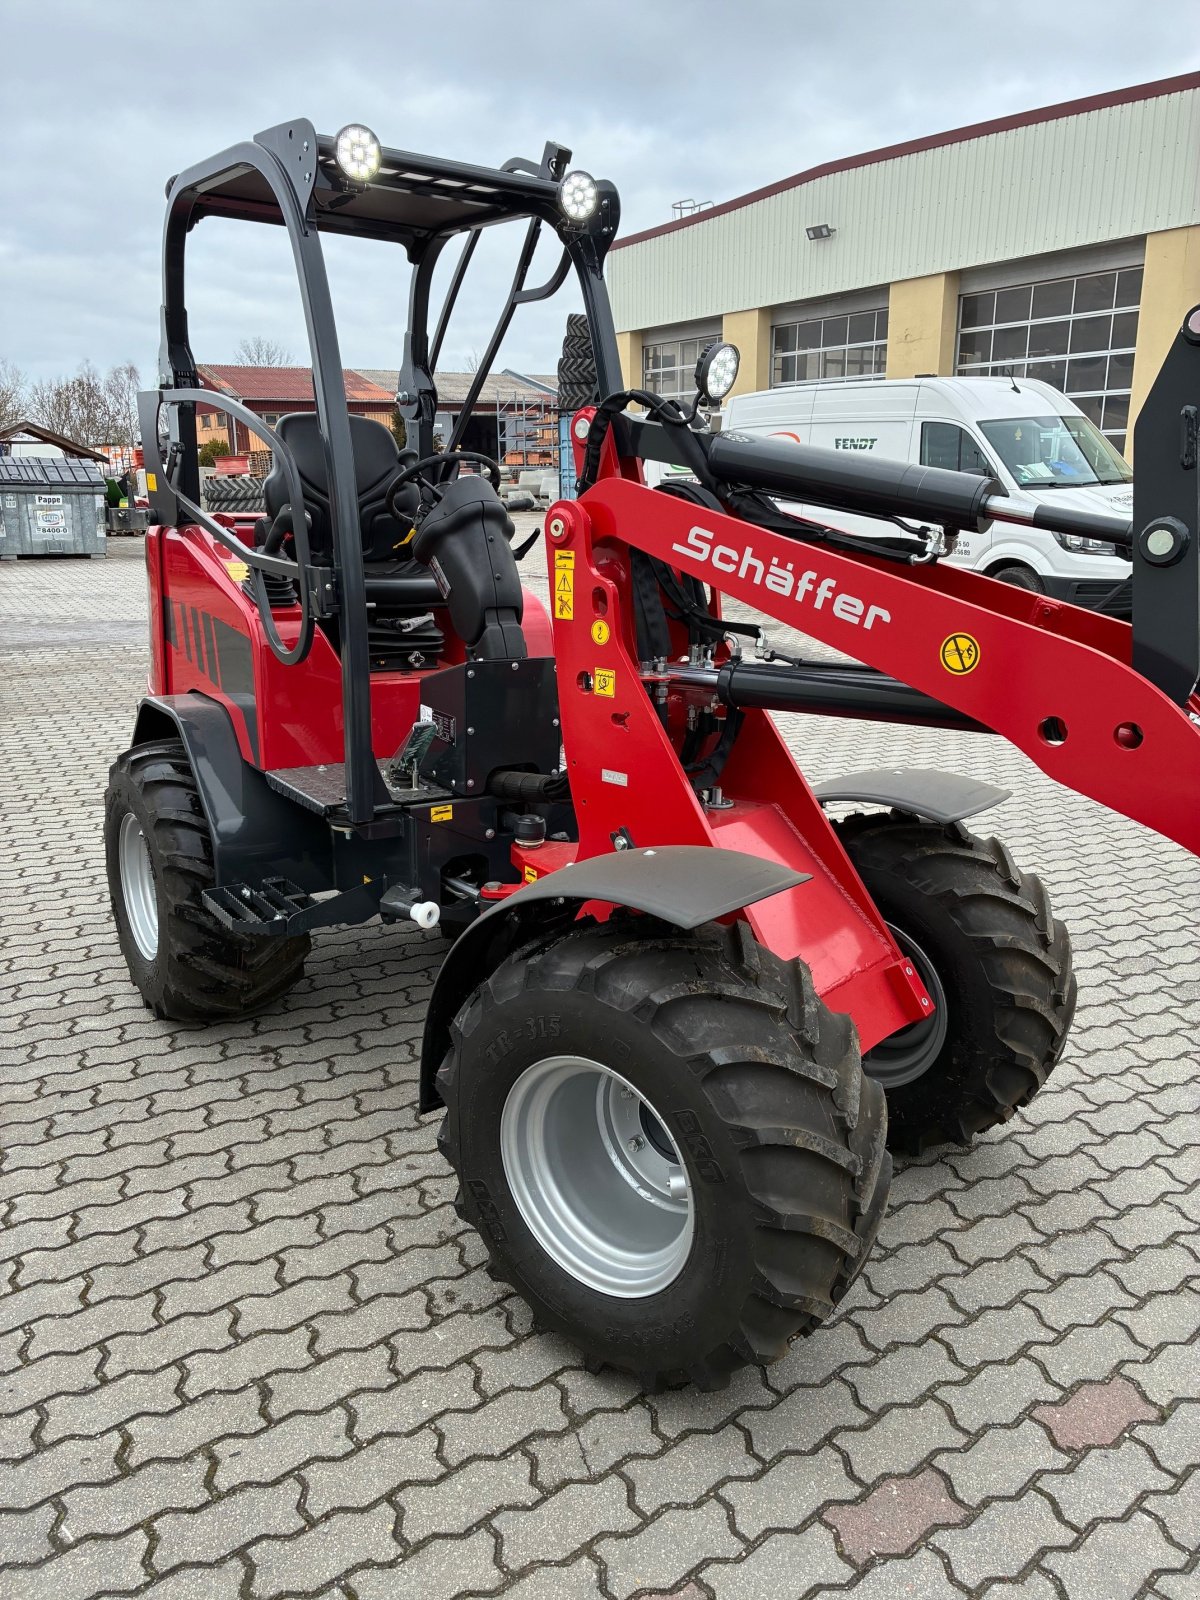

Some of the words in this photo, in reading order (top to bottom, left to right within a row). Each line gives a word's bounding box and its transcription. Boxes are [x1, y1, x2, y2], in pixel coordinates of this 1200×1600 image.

[835, 438, 878, 450] FENDT
[38, 496, 61, 504] Pappe
[672, 526, 892, 631] Schäffer
[484, 1015, 562, 1066] TR-315
[673, 1110, 726, 1184] BKT
